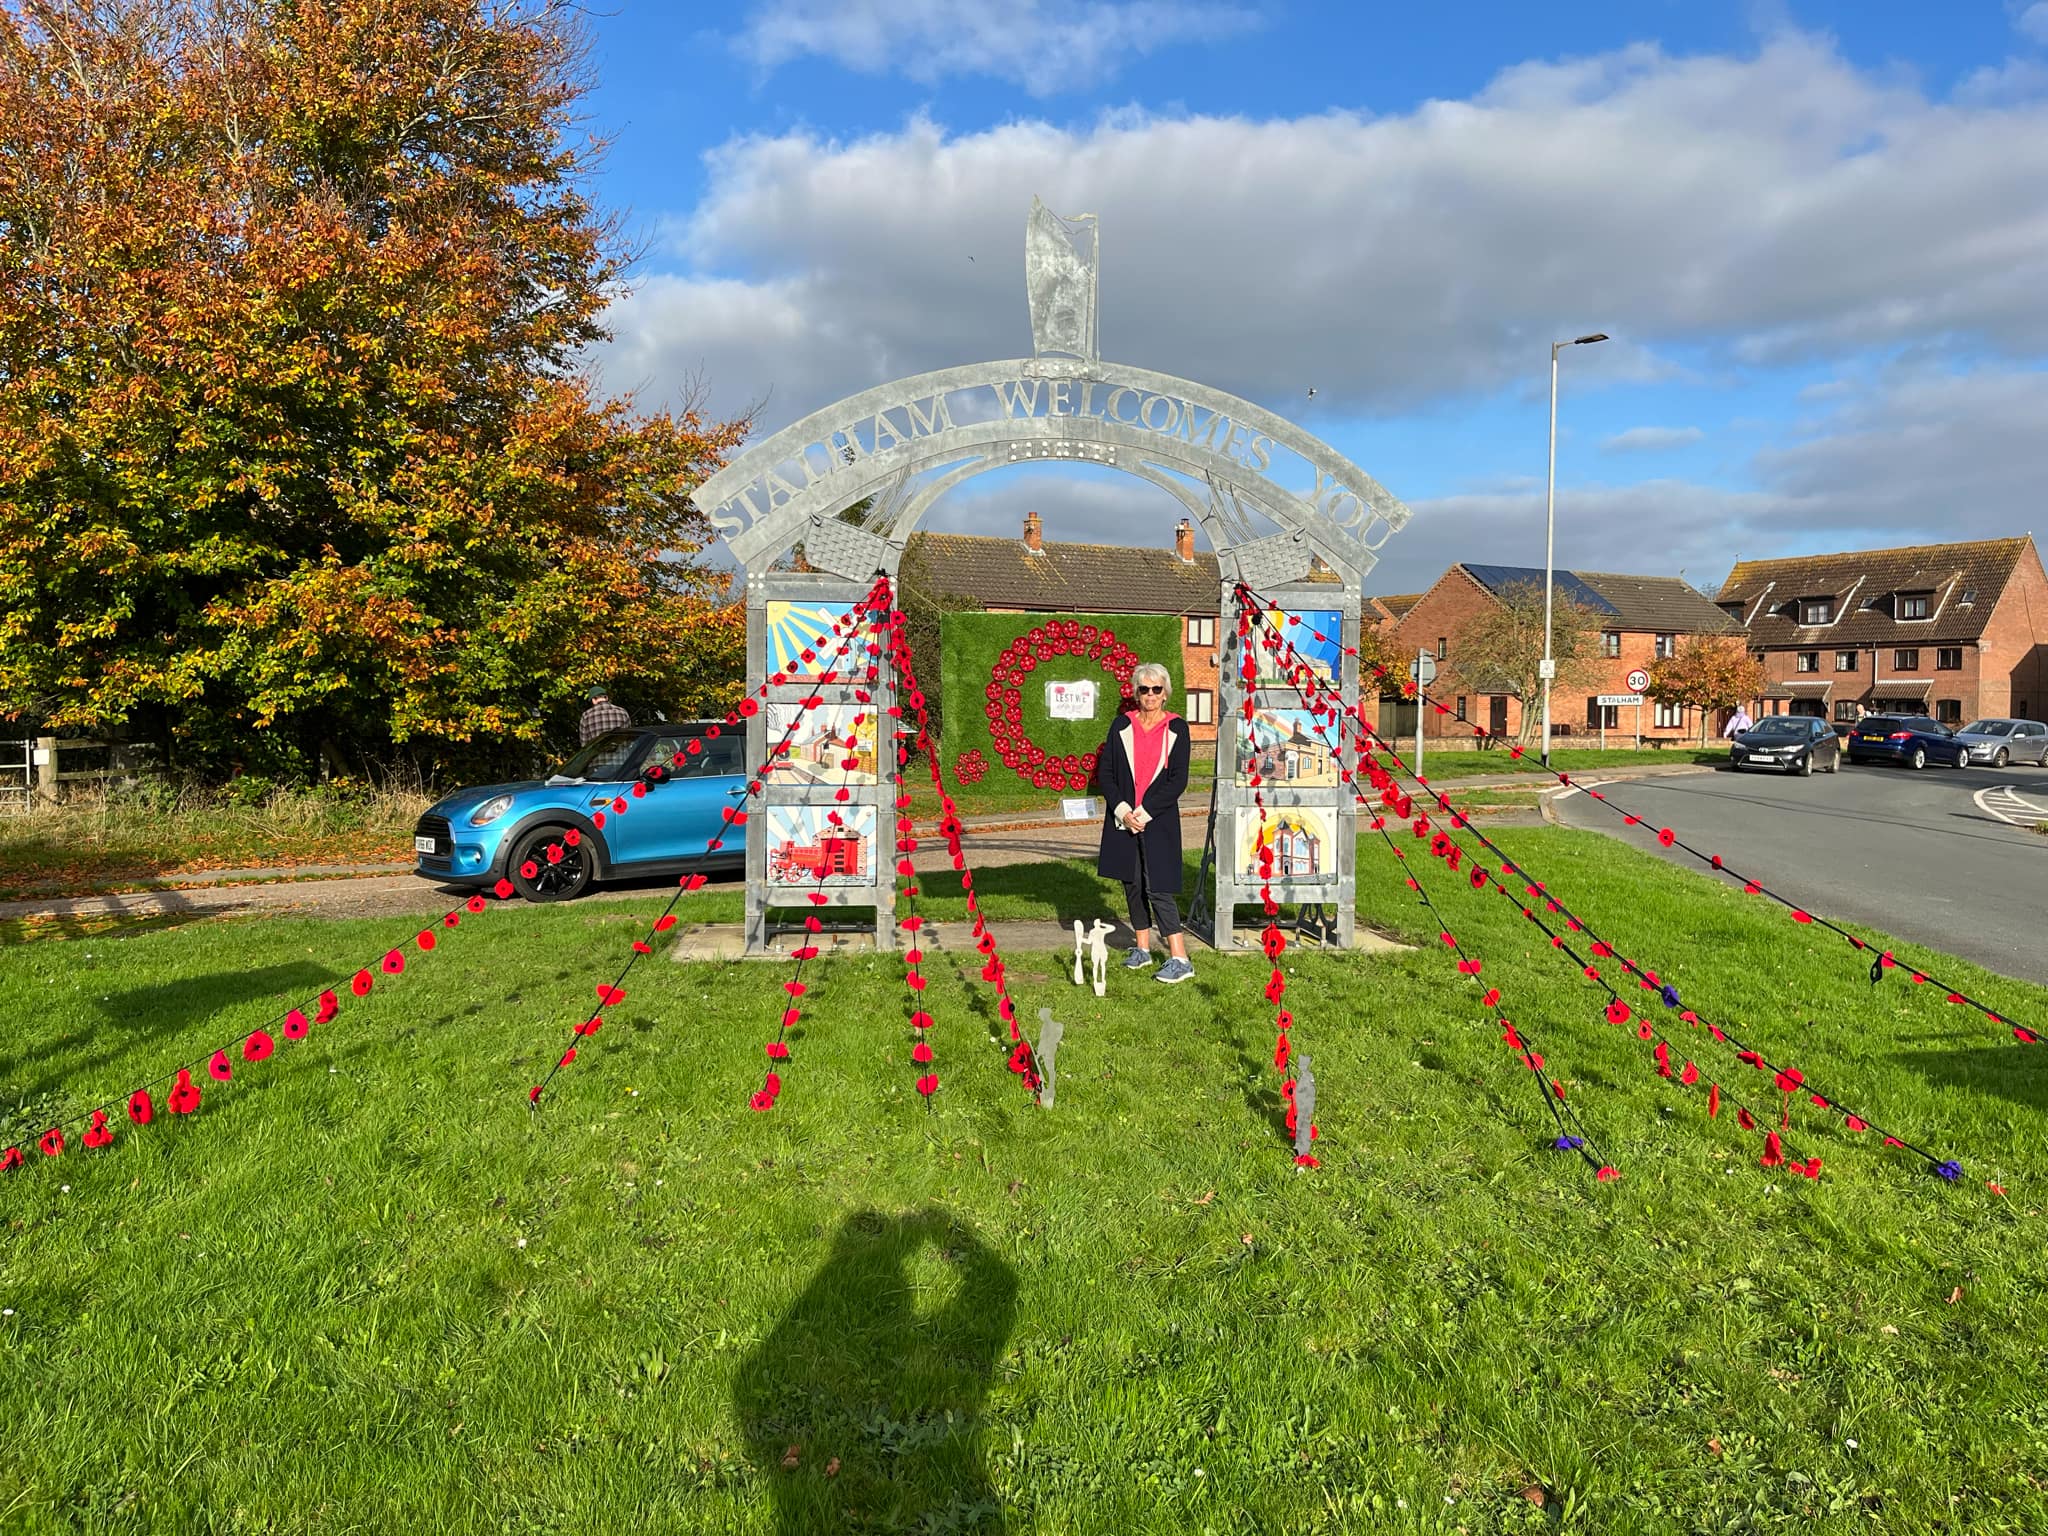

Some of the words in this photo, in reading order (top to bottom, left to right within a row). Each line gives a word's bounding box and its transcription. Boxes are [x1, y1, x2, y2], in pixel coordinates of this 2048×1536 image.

[709, 393, 957, 544] STALHAM
[990, 379, 1277, 472] WELCOMES
[1304, 464, 1399, 551] YOU
[1630, 676, 1646, 686] 30
[1055, 693, 1074, 703] LEST
